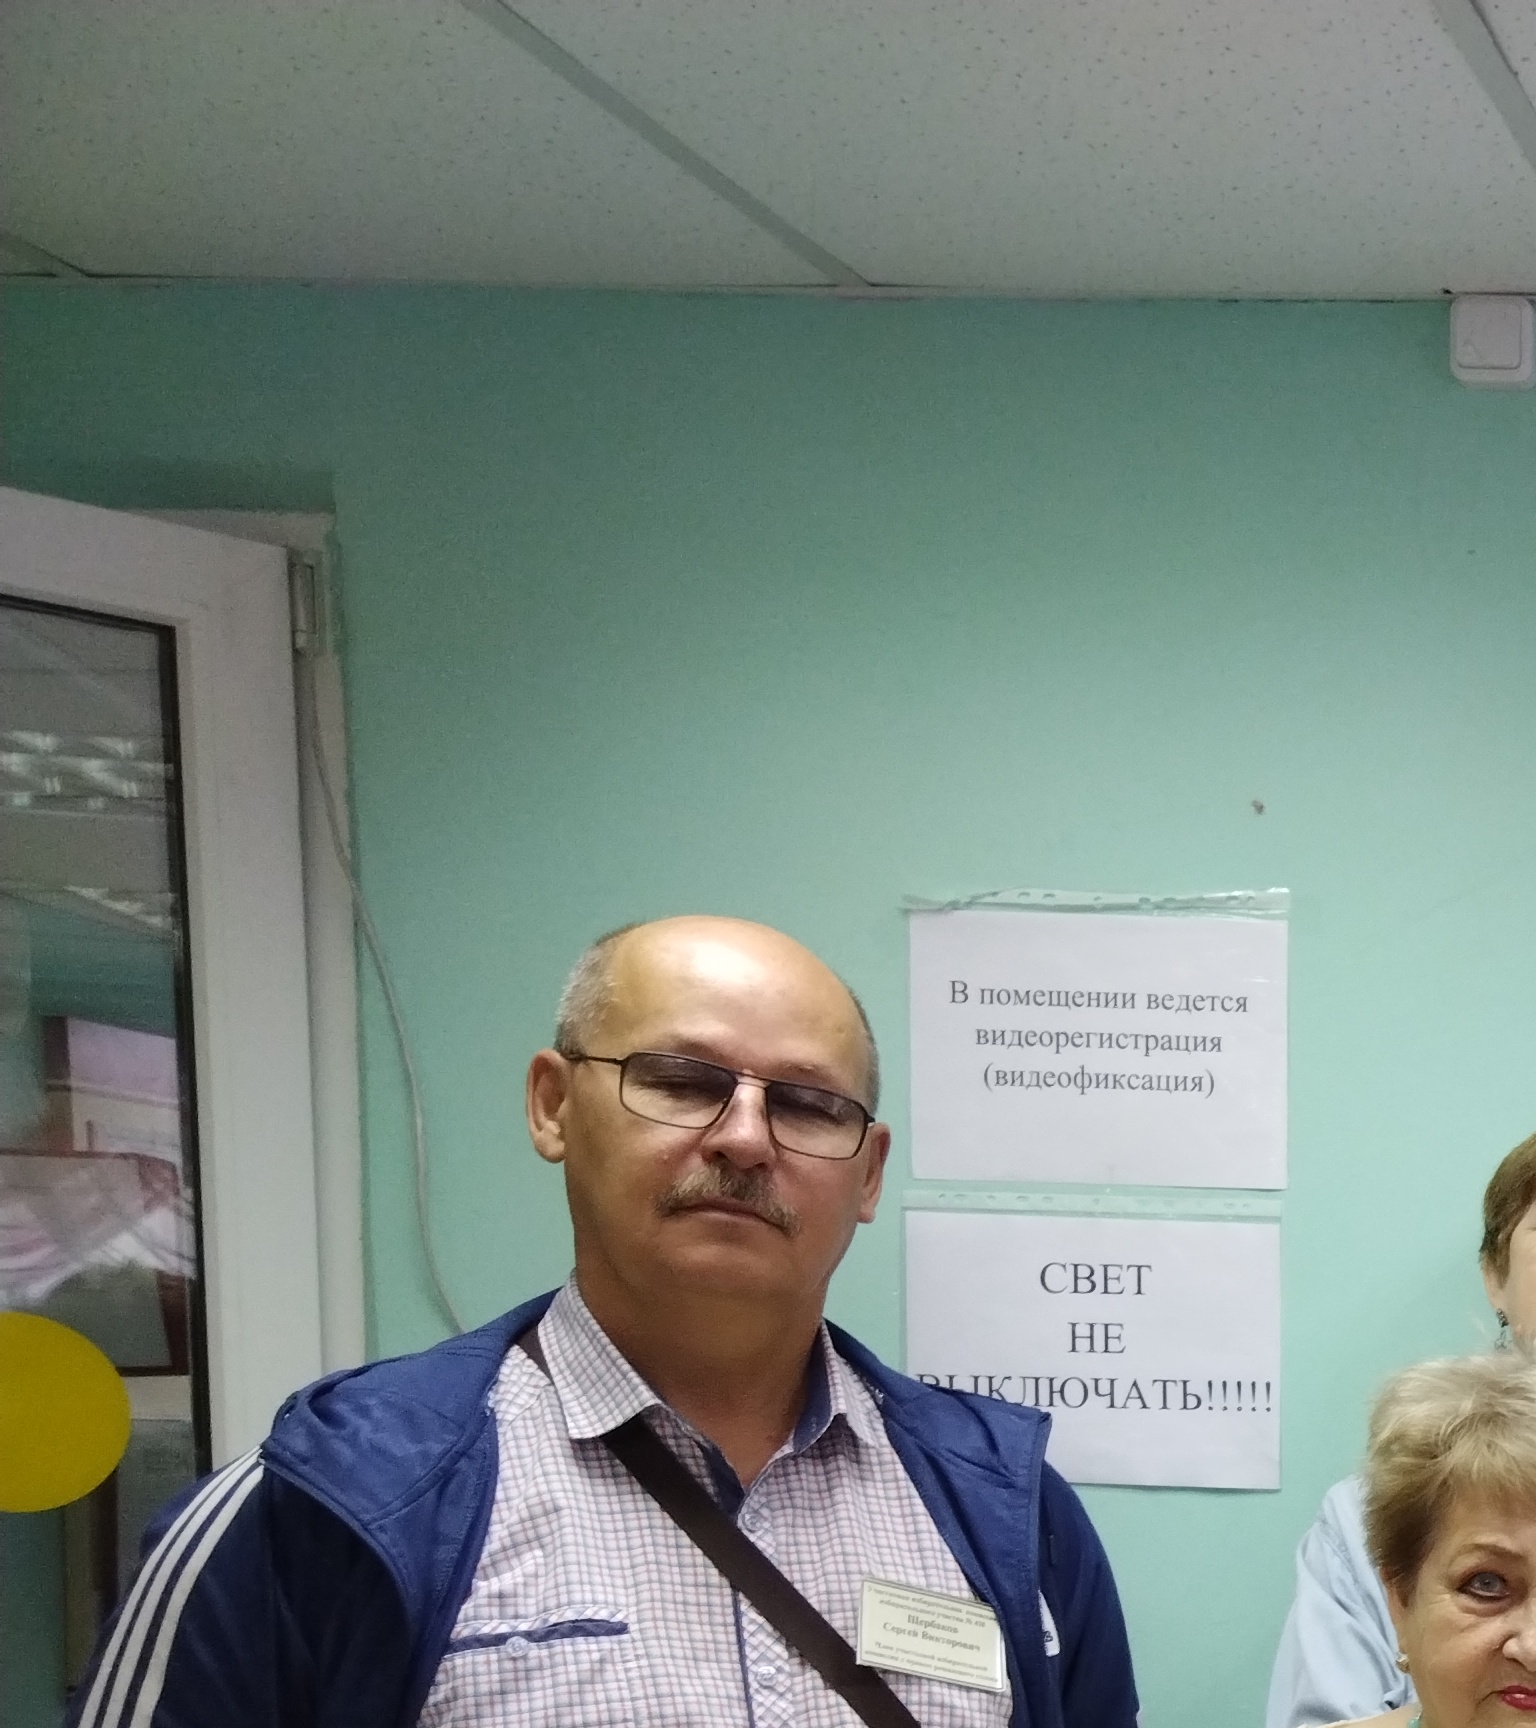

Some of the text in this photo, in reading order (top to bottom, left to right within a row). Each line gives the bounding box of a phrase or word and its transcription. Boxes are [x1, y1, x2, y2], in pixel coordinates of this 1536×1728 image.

[949, 980, 1249, 1016] В помещении ведется
[975, 1027, 1223, 1055] видеорегистрация
[983, 1062, 1215, 1099] (видеофиксация)
[1039, 1262, 1152, 1296] СВЕТ
[1067, 1322, 1127, 1354] НЕ
